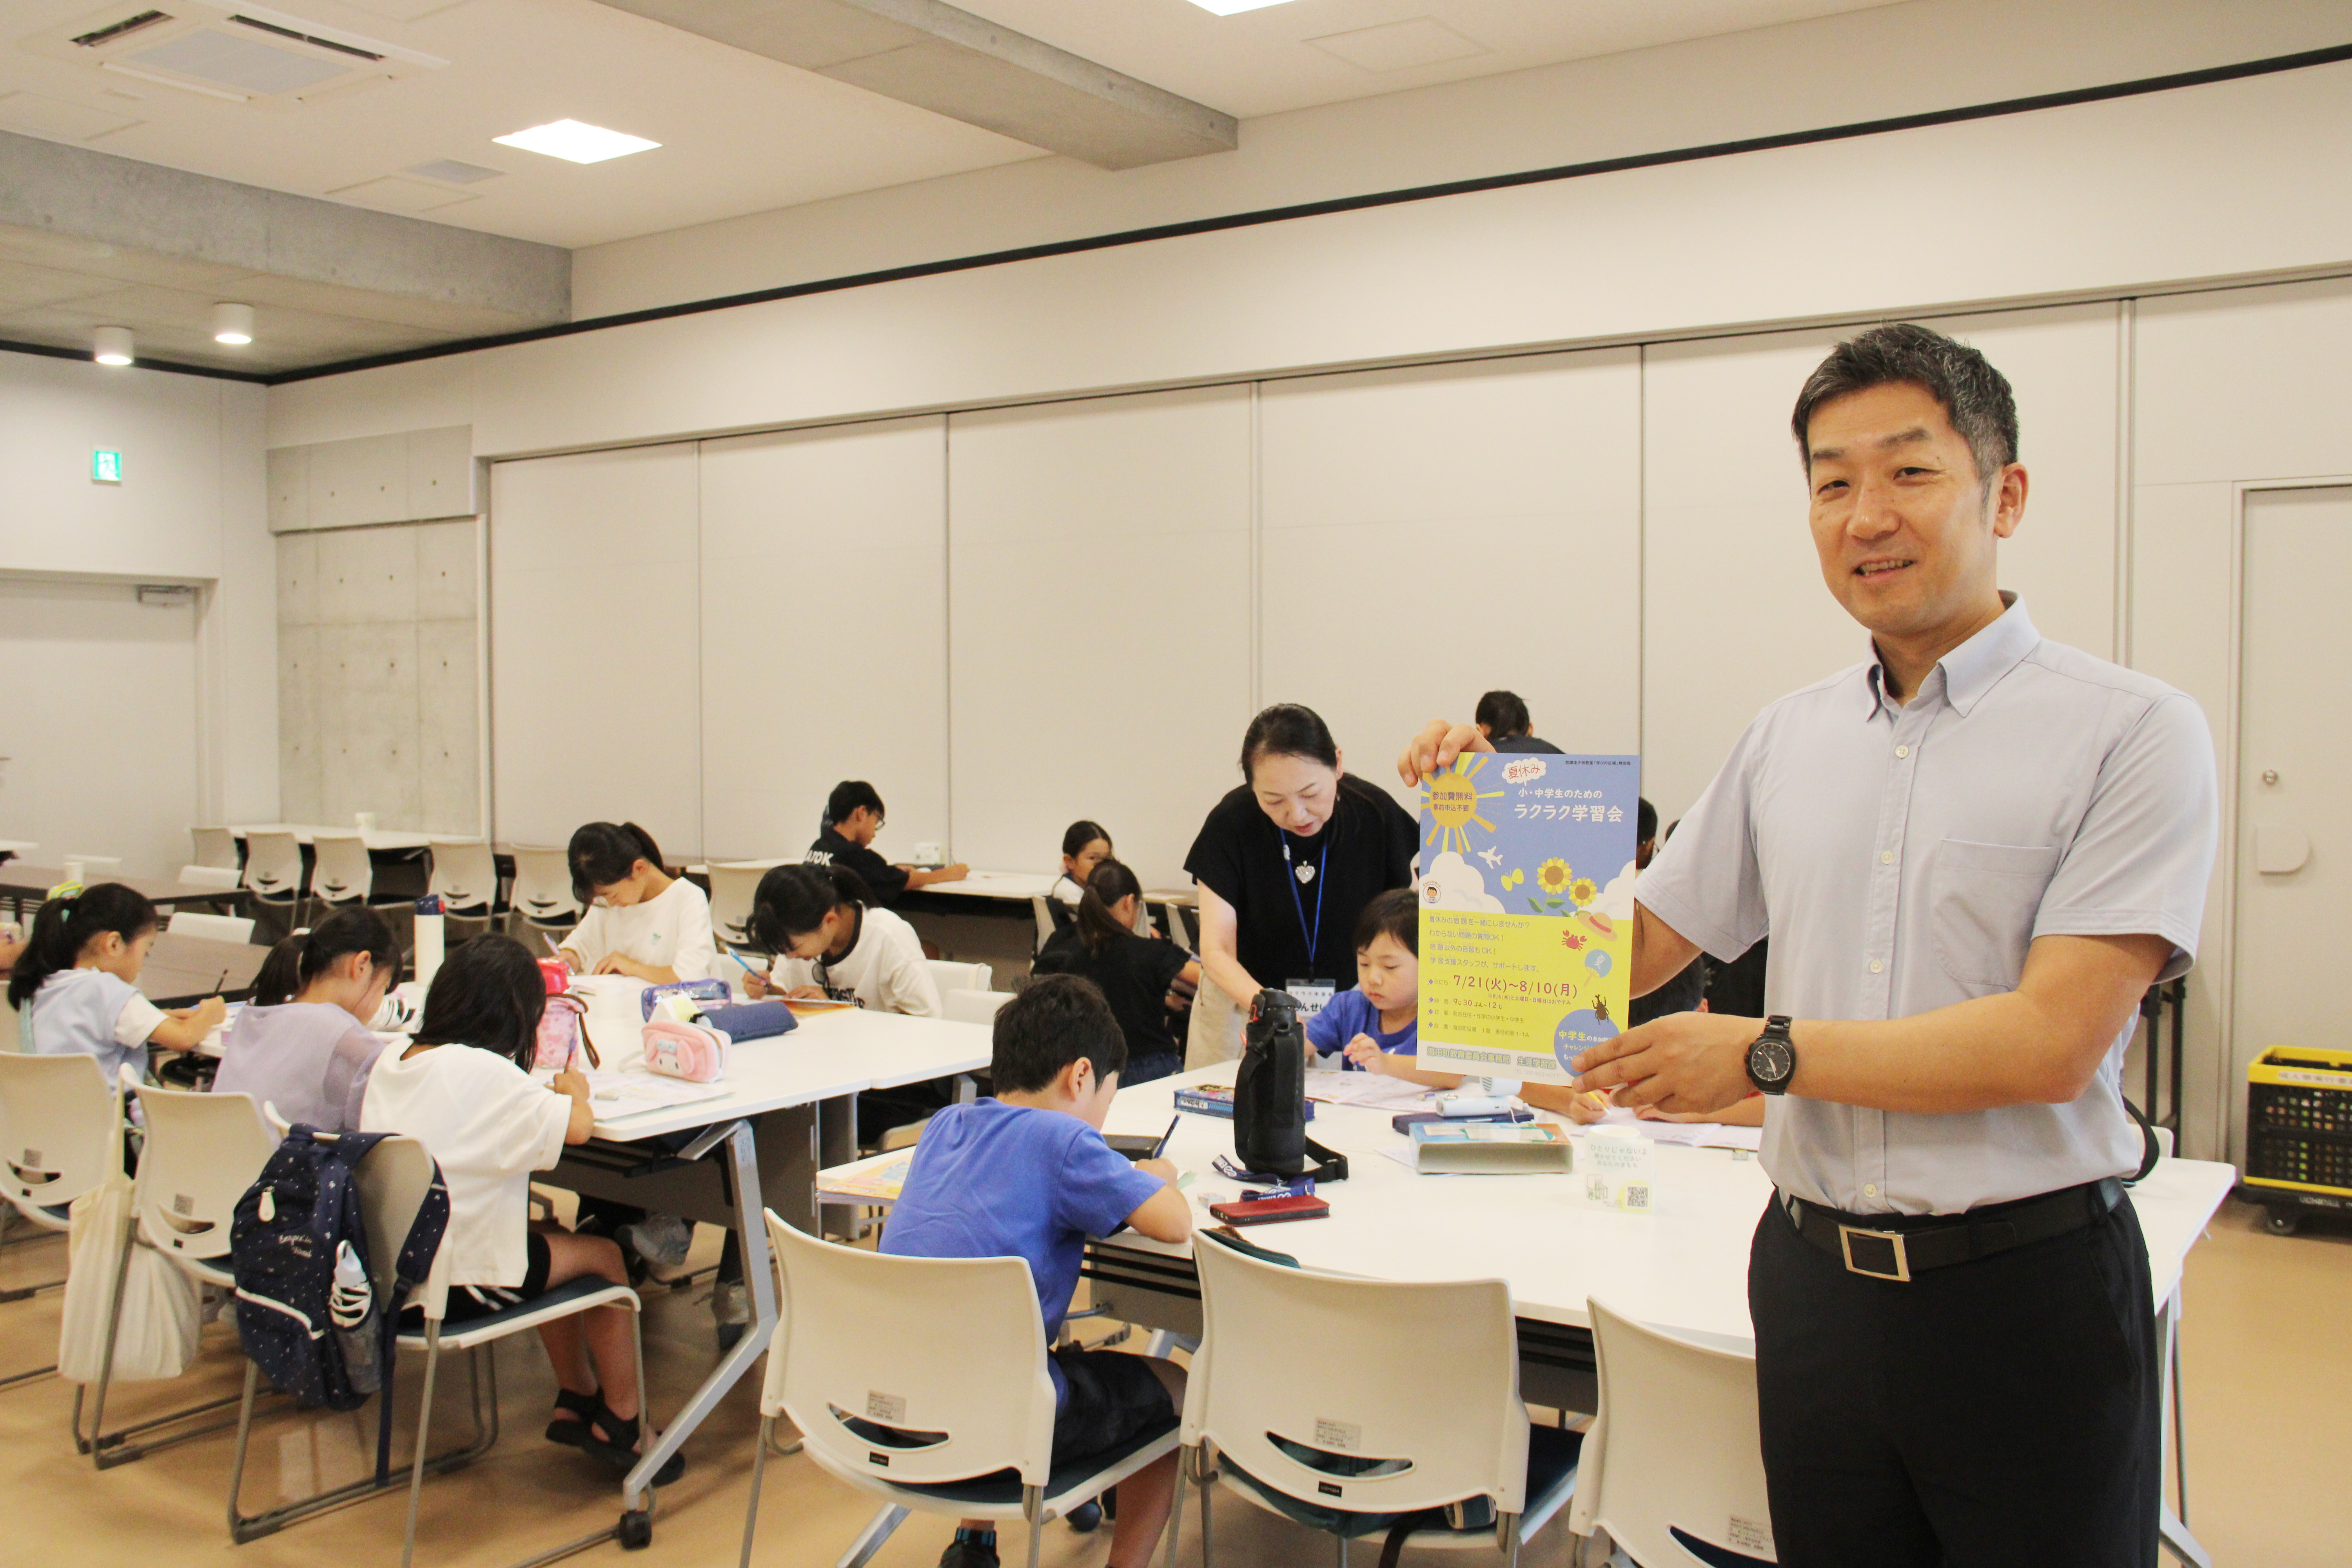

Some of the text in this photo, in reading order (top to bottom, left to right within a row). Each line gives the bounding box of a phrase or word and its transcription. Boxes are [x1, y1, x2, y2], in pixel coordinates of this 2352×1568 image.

[1508, 764, 1541, 779] 夏休み
[1432, 791, 1473, 801] 参加費無料
[1518, 787, 1602, 799] 小・中学生のための
[1514, 804, 1624, 823] ラクラク学習会
[1590, 1144, 1647, 1155] ひとりじゃないよ
